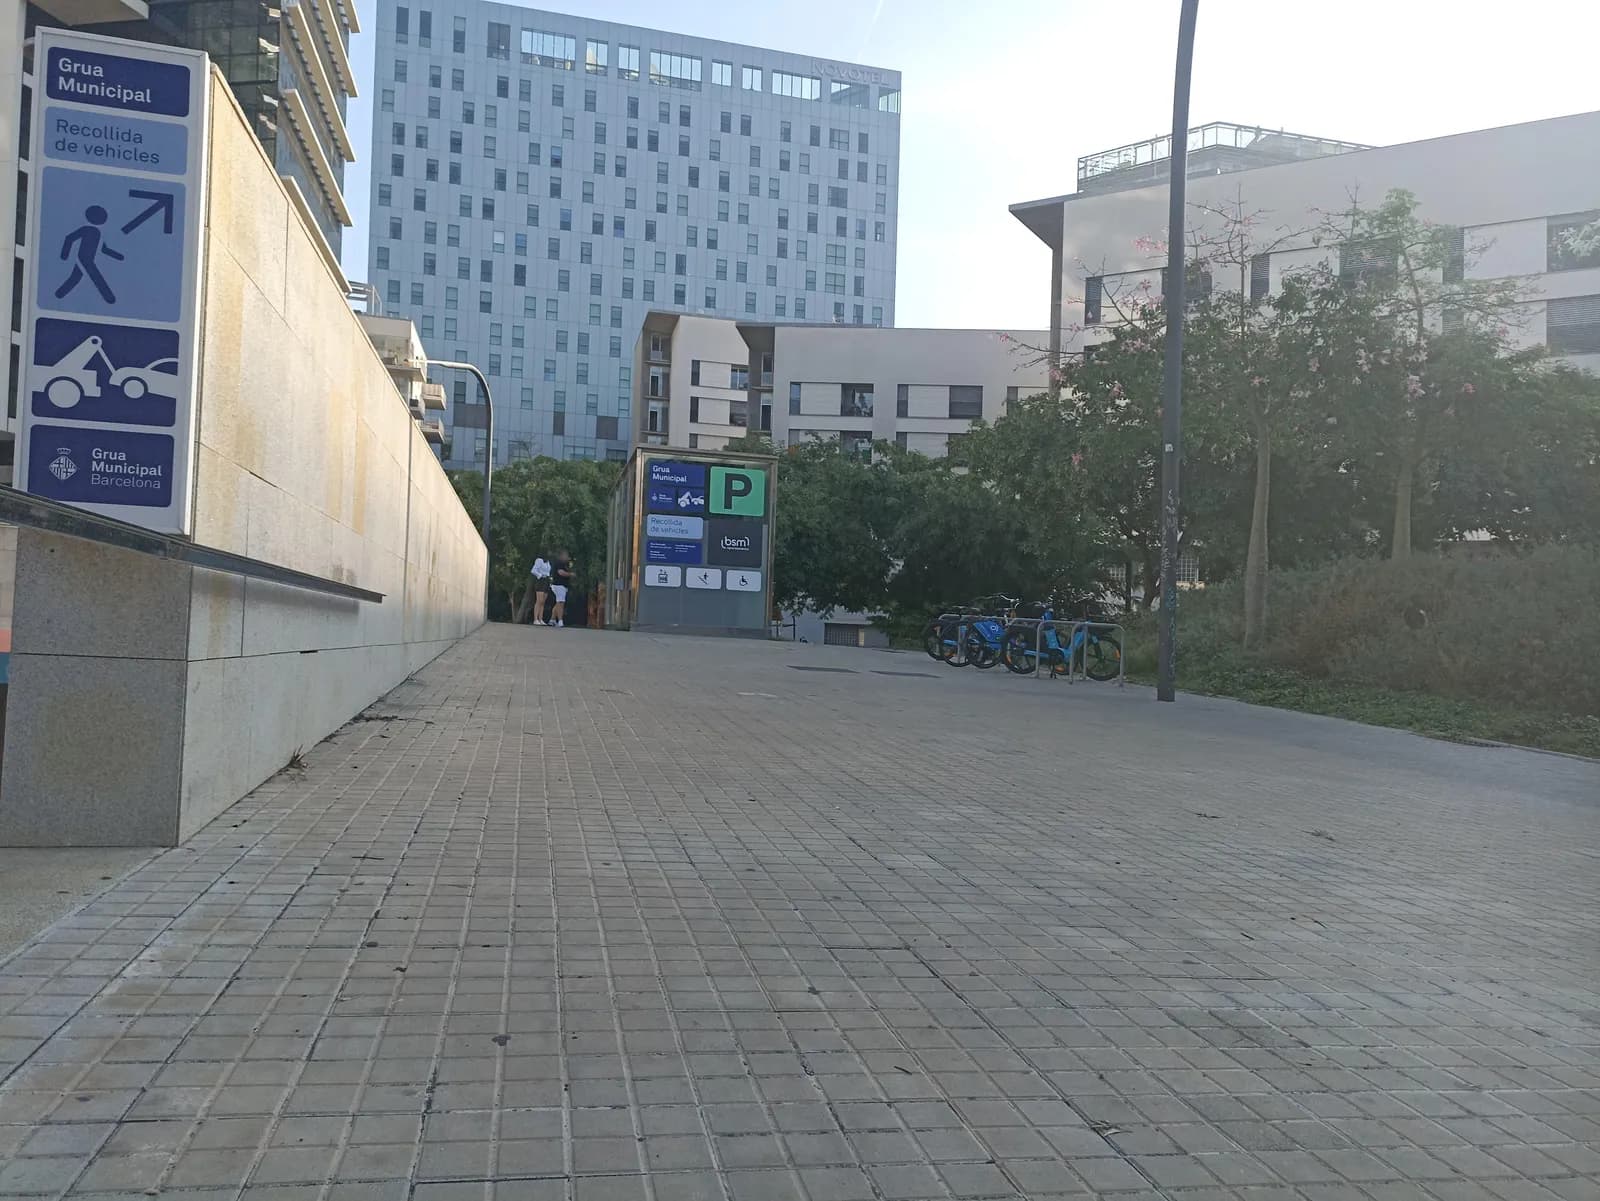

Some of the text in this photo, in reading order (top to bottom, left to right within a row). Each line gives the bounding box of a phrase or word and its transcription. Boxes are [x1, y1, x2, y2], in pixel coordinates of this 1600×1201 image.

[58, 57, 104, 78] Grua
[811, 60, 890, 86] NOVOTEL
[58, 76, 152, 104] Municipal
[56, 118, 143, 145] Recollida
[55, 138, 160, 165] de vehicles
[91, 447, 127, 461] Grua
[91, 460, 162, 478] Municipal
[652, 465, 670, 473] Grua
[91, 473, 161, 489] Barcelona
[652, 473, 687, 484] Municipal
[723, 472, 753, 510] P
[651, 517, 683, 527] Recollida
[660, 526, 689, 535] vehicles
